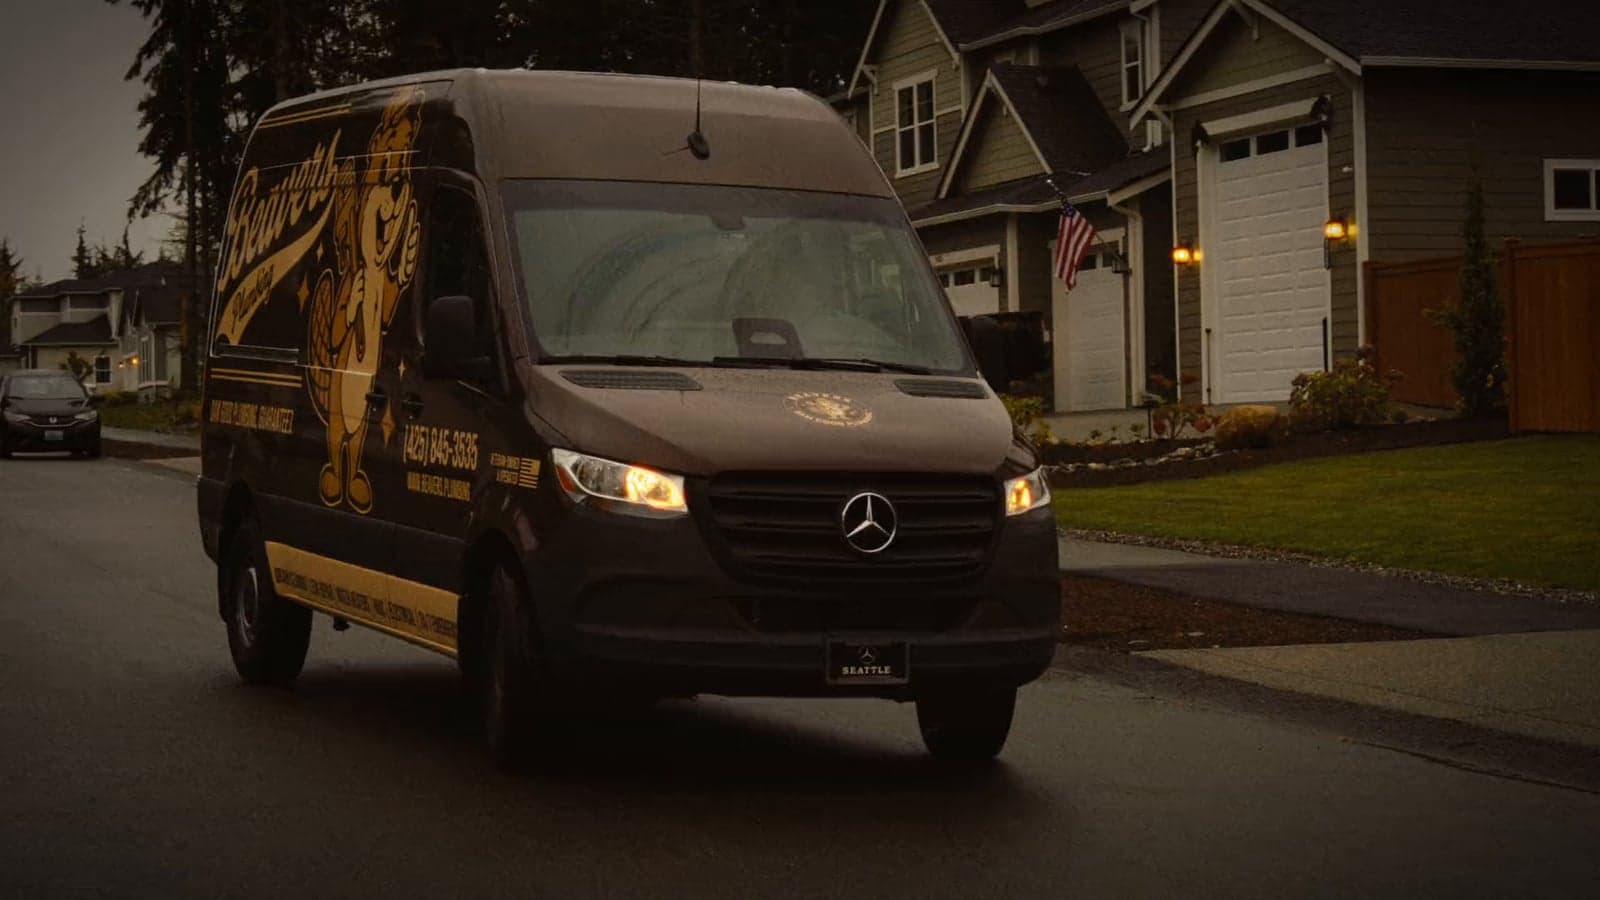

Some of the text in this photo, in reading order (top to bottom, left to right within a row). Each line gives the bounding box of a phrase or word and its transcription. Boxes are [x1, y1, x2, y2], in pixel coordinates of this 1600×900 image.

[403, 424, 479, 471] (425) 845-3535
[841, 666, 892, 675] SEATTLE
